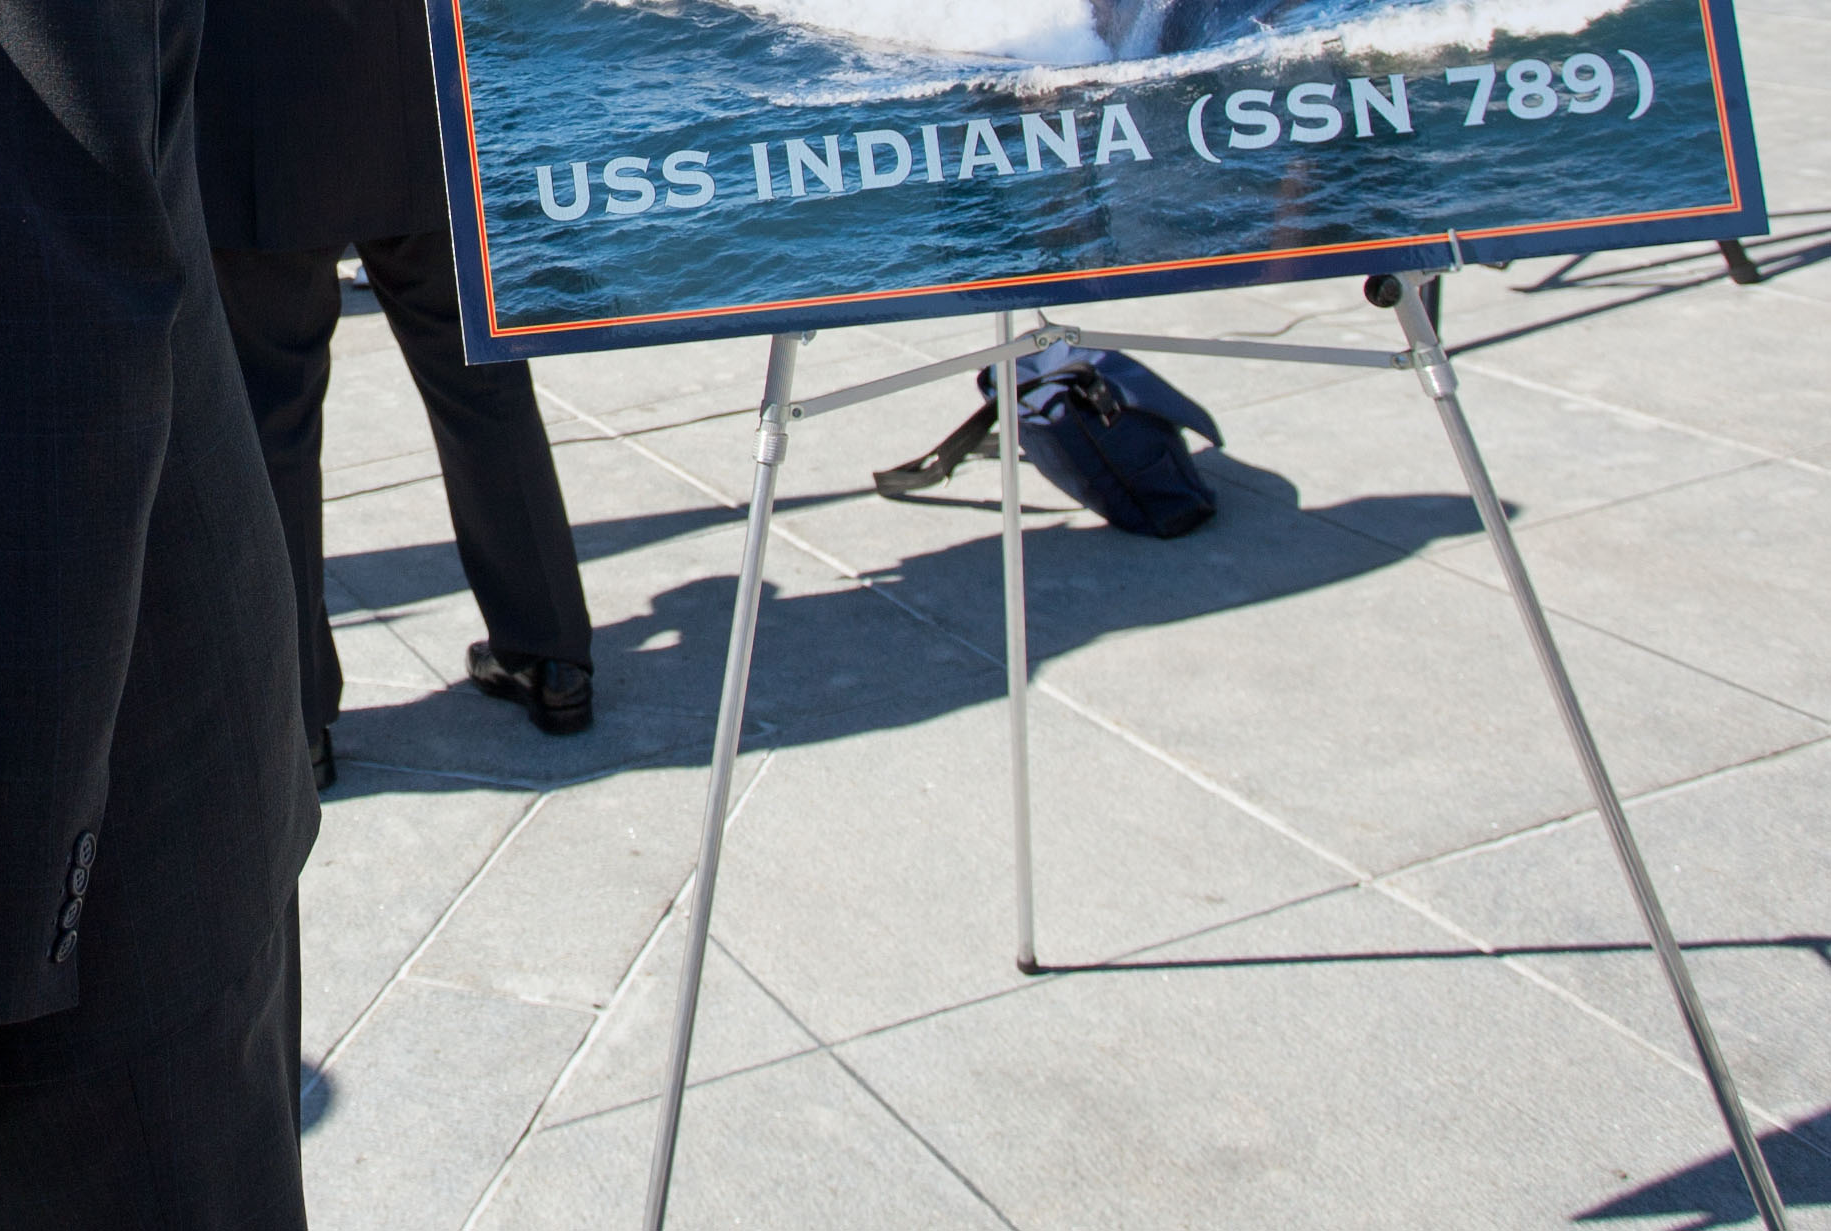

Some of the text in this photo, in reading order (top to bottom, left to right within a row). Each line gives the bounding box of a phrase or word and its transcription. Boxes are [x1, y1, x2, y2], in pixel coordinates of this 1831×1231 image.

[536, 48, 1656, 221] USS INDIANA (SSN 789)
